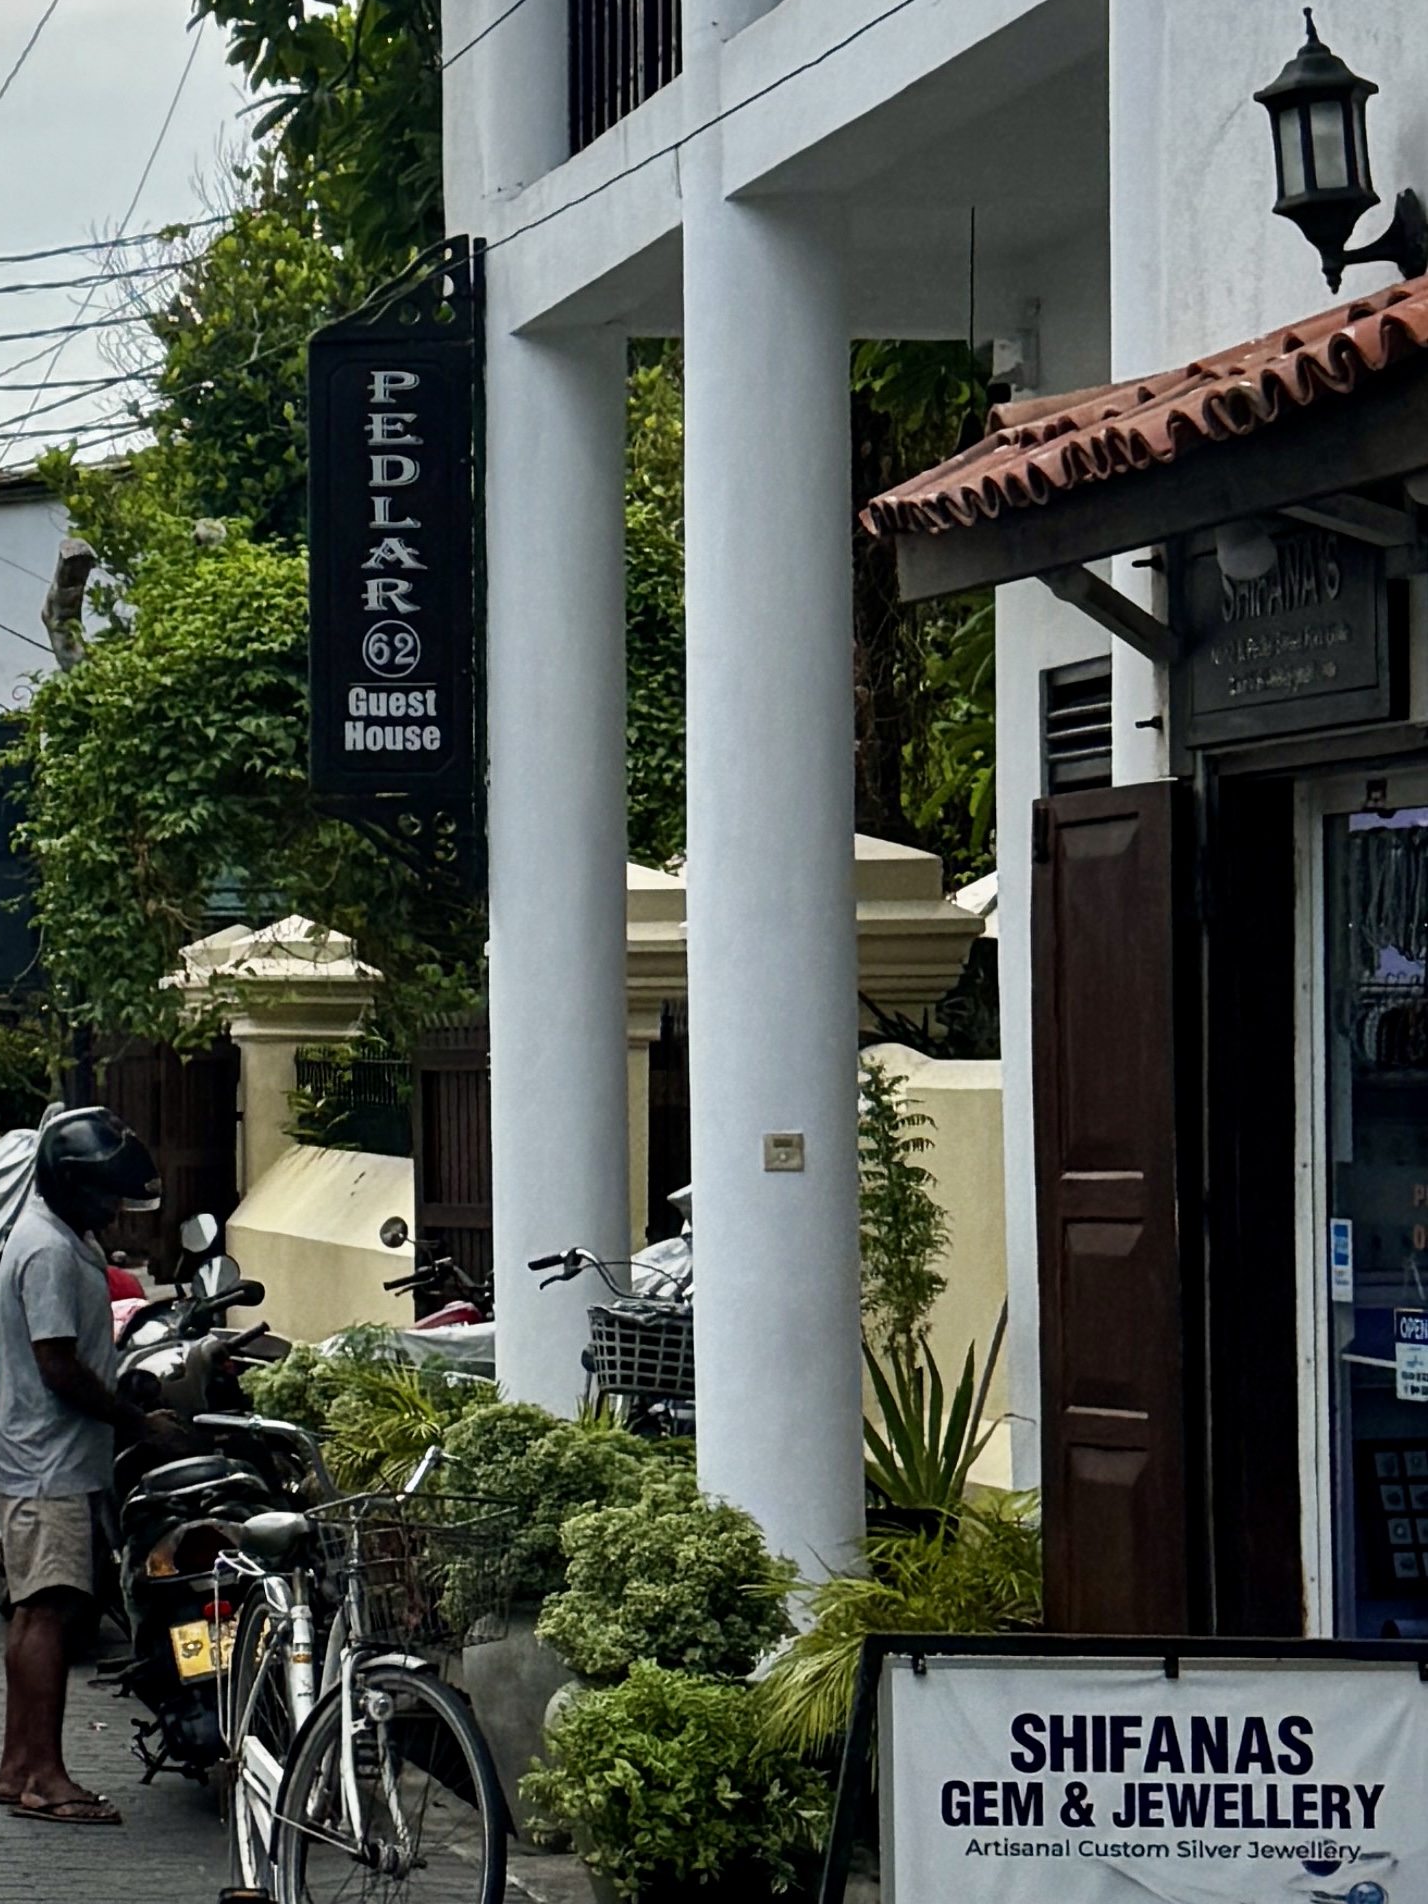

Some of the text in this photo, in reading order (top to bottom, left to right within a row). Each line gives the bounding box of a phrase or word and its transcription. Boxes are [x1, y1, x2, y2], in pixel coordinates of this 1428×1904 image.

[360, 369, 429, 613] PEDLAR
[367, 632, 417, 667] 62
[347, 686, 438, 718] Guest
[344, 720, 441, 753] House
[1010, 1712, 1315, 1775] SHIFANAS
[941, 1780, 1386, 1830] GEM & JEWELLERY
[965, 1838, 1362, 1864] Artisanal Custom Silver Jewellery
